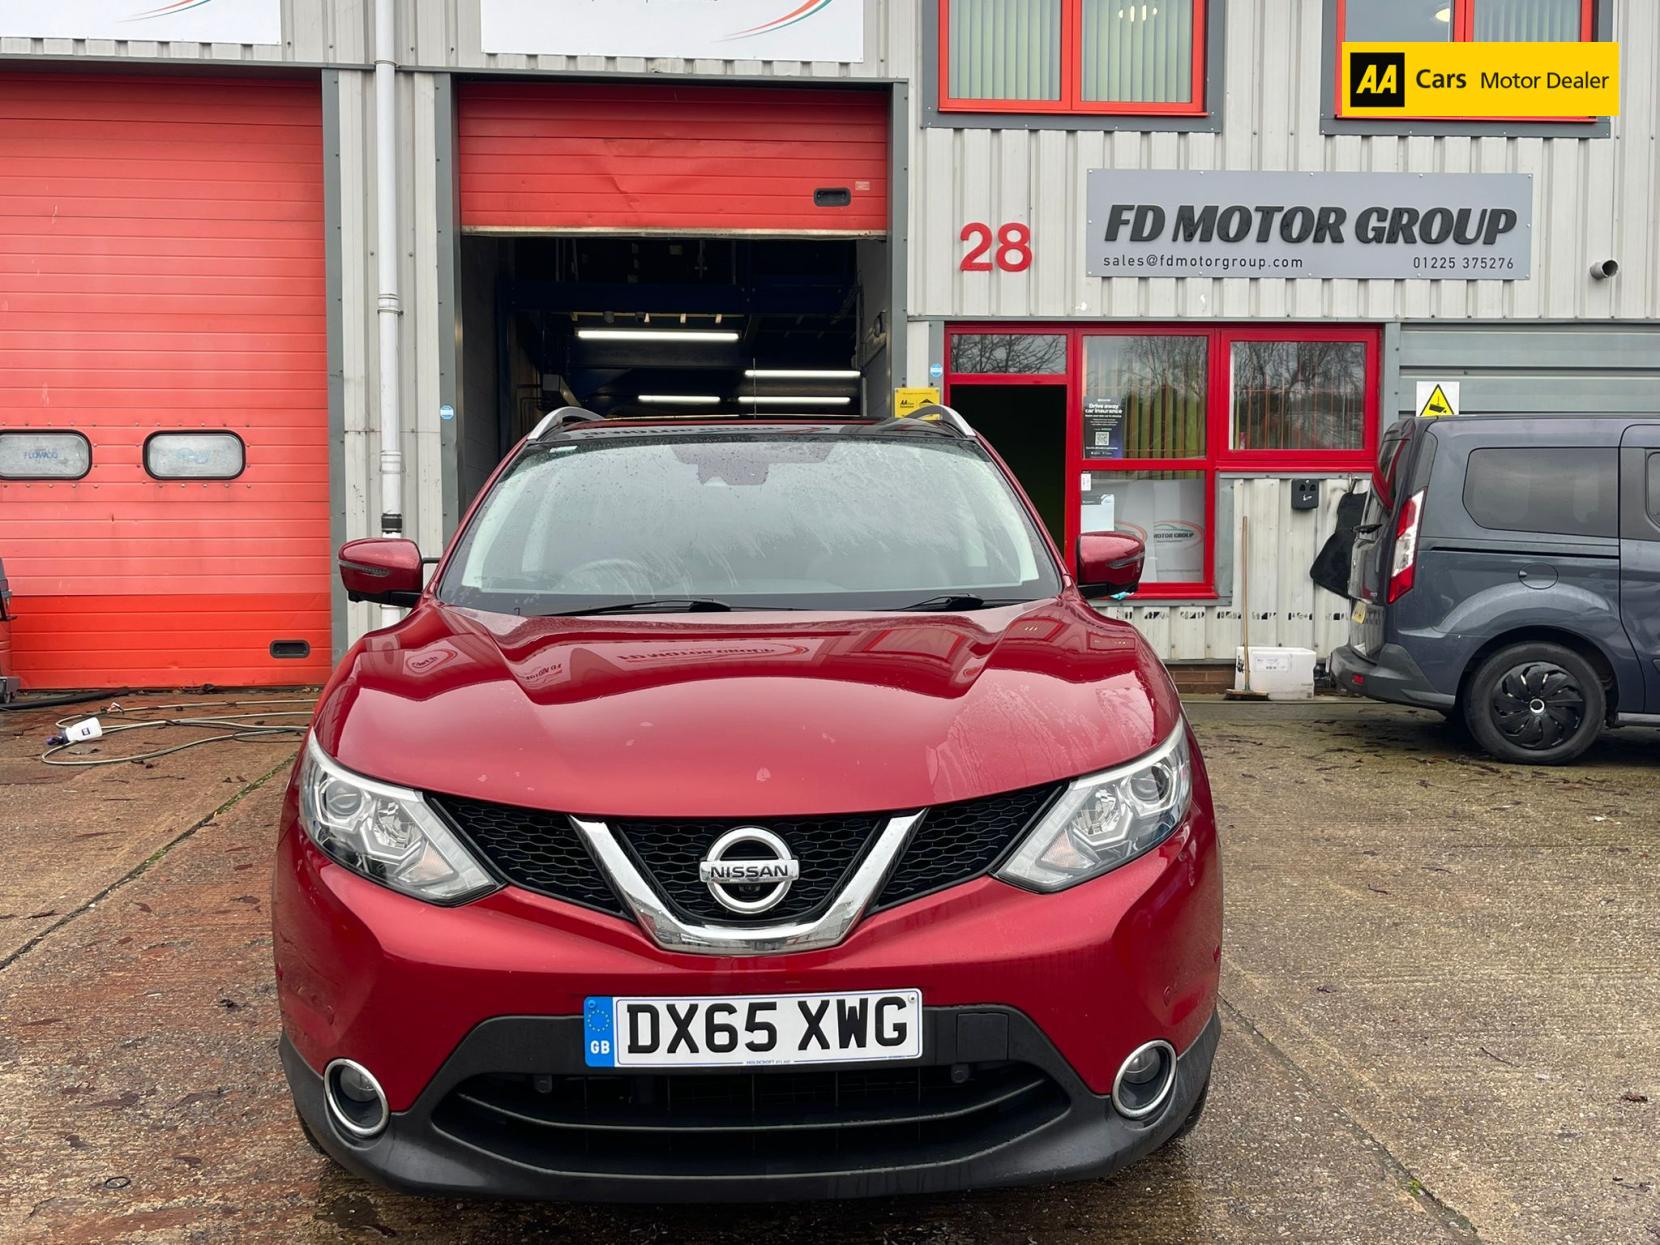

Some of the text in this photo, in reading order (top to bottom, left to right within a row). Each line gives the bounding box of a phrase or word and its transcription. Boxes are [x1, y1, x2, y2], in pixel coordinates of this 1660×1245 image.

[1104, 204, 1518, 246] FD MOTOR GROUP
[961, 223, 1032, 272] 28
[1102, 254, 1515, 270] sales@fdmotorgroup.com 01225 375276
[710, 865, 788, 879] NISSAN
[627, 997, 908, 1054] DX65 XWG
[590, 1041, 610, 1054] GB
